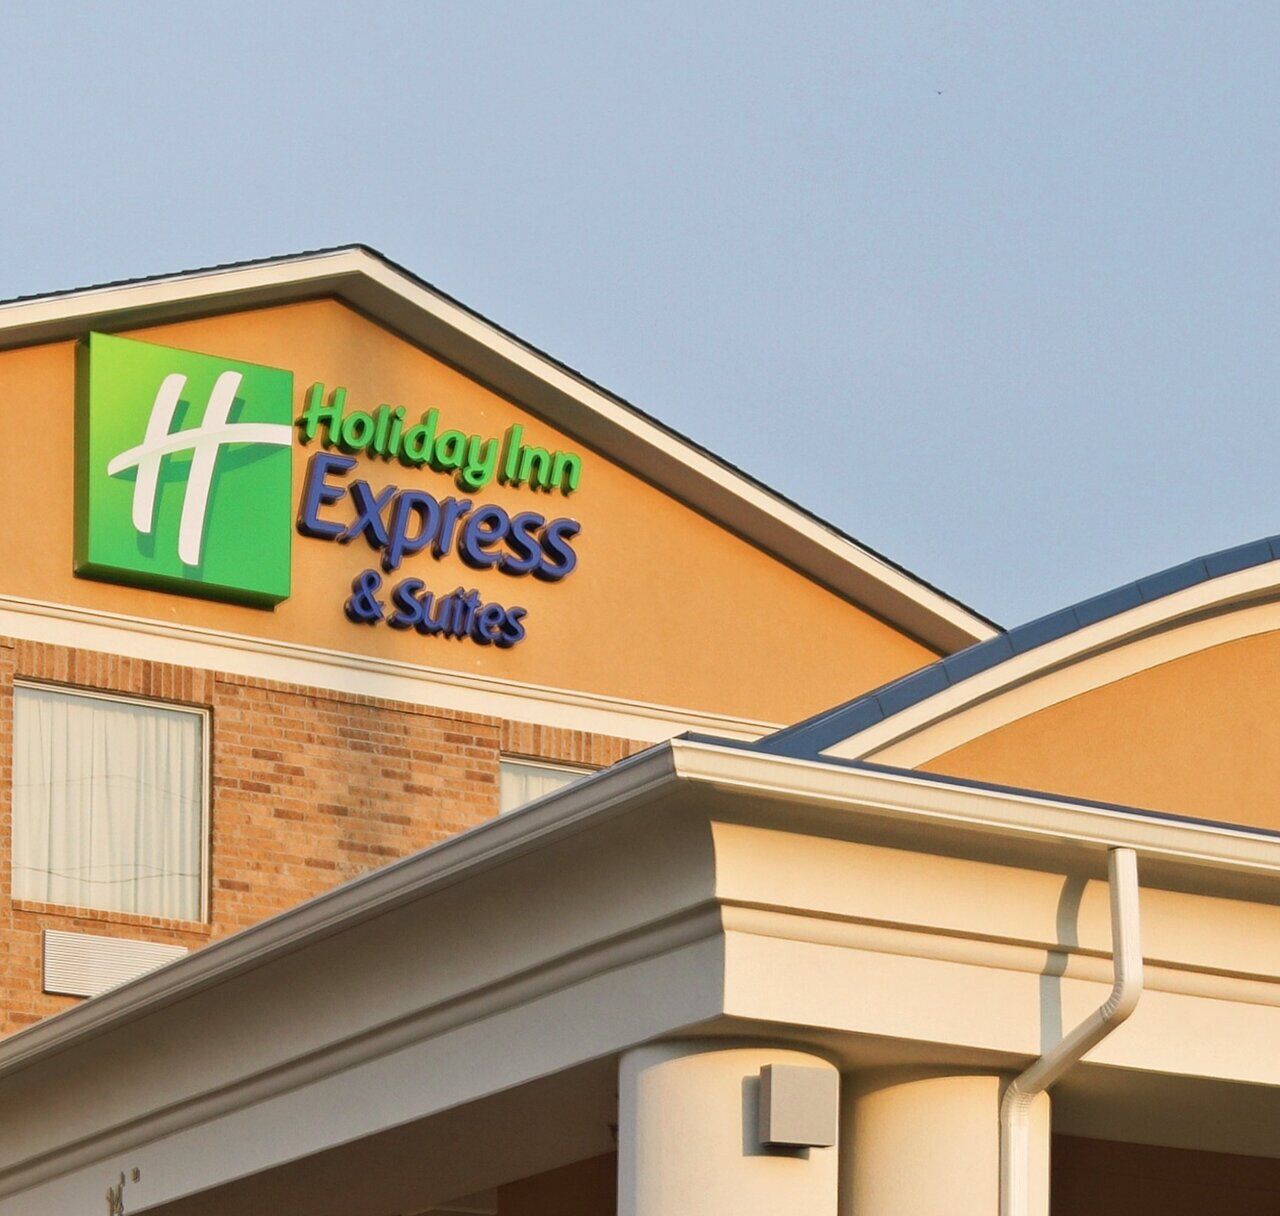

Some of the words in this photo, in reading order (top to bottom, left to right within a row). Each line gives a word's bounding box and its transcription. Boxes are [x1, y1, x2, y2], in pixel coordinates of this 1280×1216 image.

[296, 382, 499, 491] Holiday
[498, 423, 581, 496] Inn
[297, 451, 581, 581] Express
[344, 569, 384, 624] &
[387, 577, 527, 648] Suites
